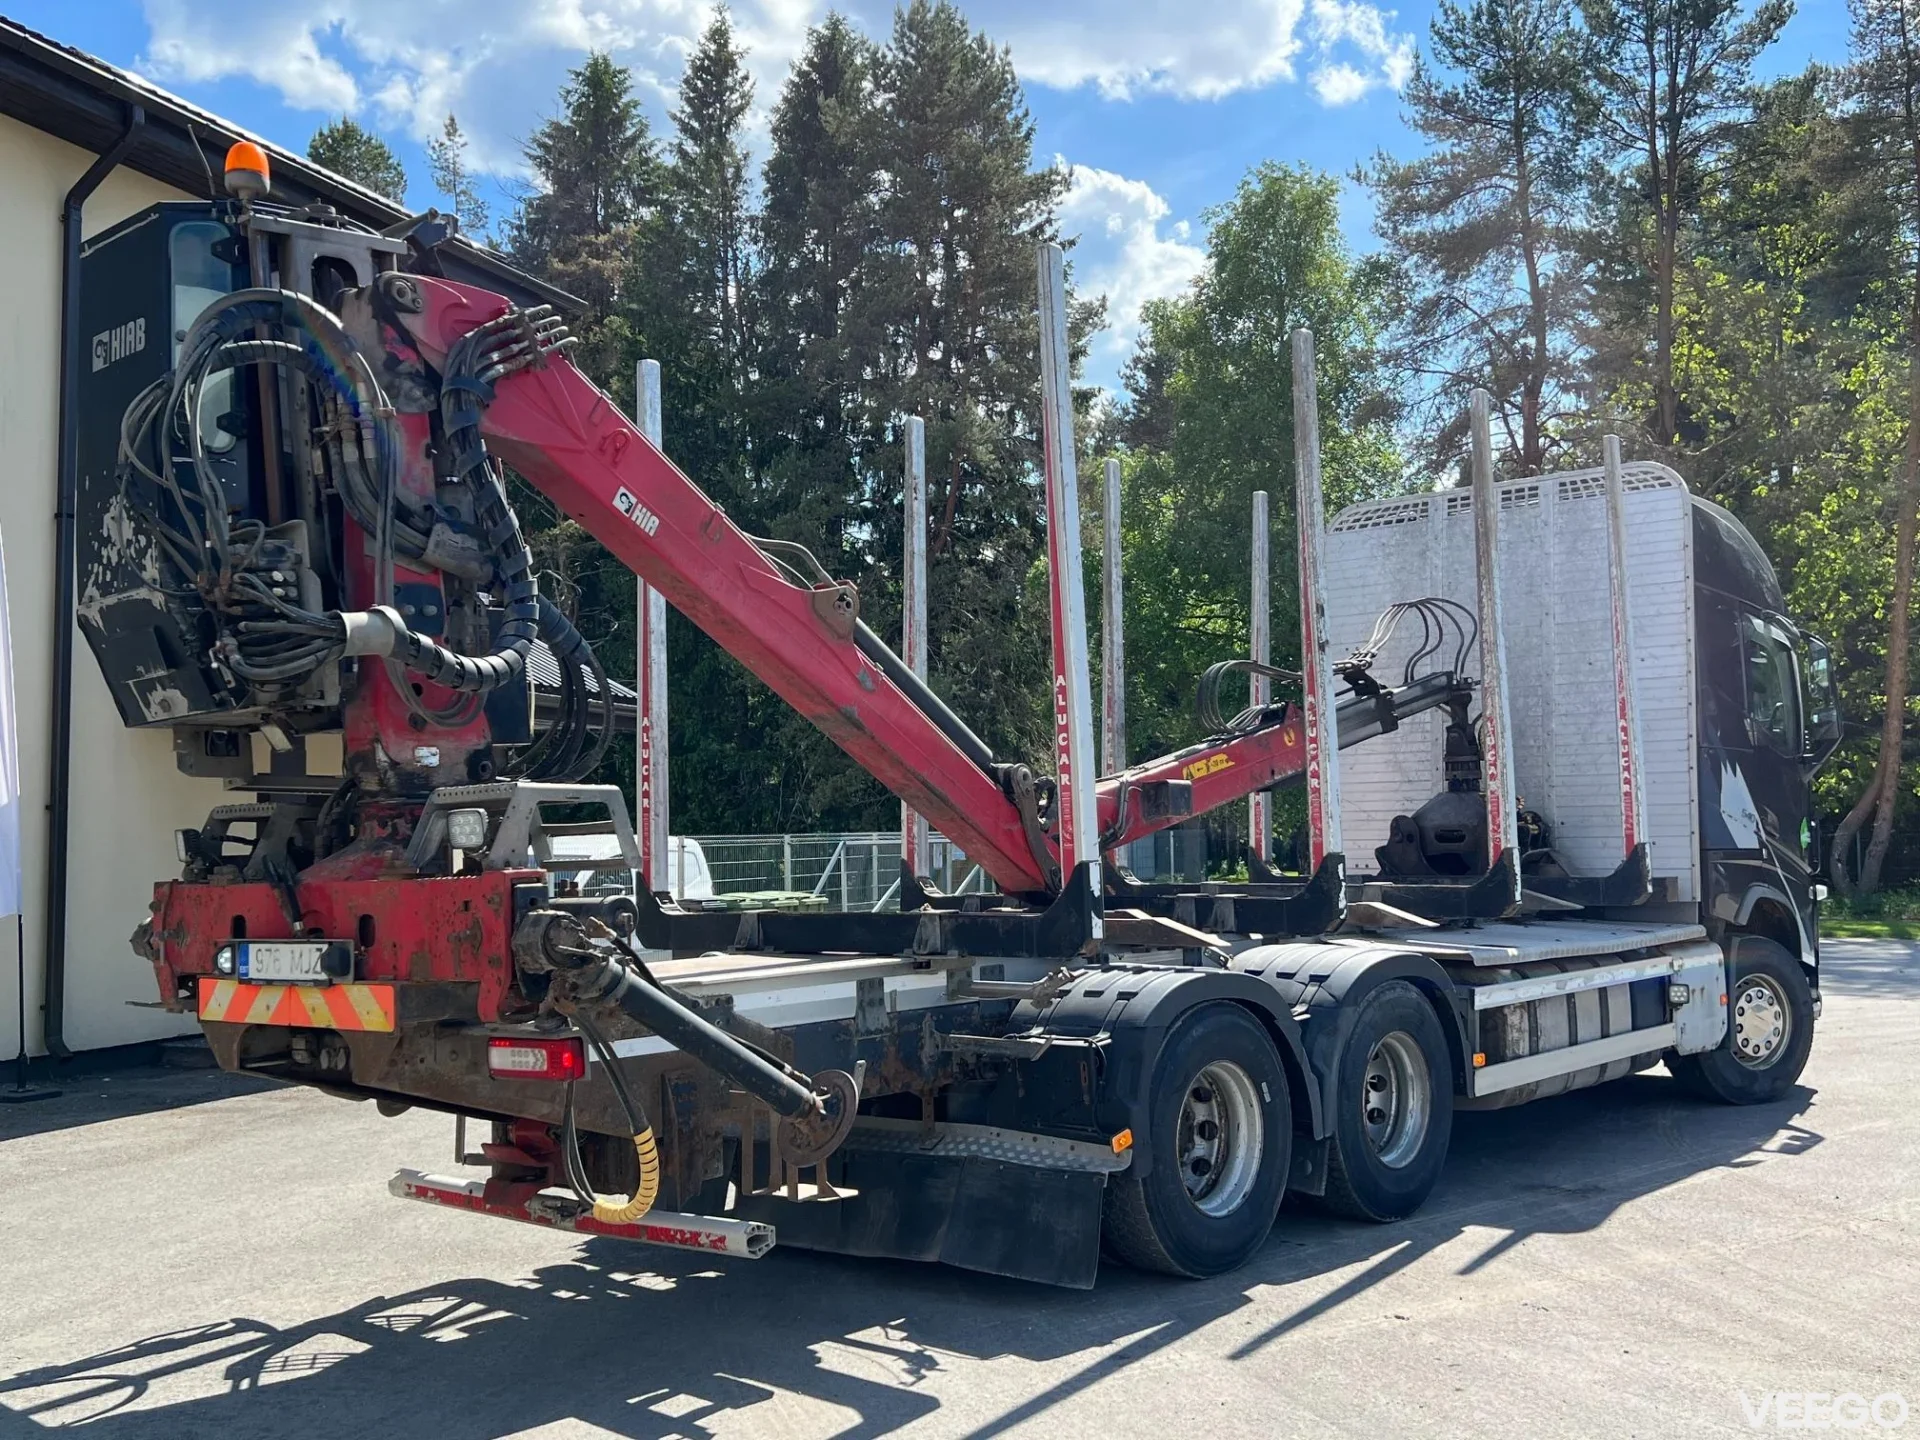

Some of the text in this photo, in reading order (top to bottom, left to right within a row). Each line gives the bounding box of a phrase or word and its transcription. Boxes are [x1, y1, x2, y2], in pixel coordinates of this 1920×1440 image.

[111, 317, 146, 362] HIAB
[642, 716, 650, 809] ALUCAR
[1055, 674, 1071, 786] ALUCAR
[1306, 694, 1320, 789] ALUCAR
[1618, 718, 1632, 793] ALUCAR
[290, 947, 323, 975] MJZ
